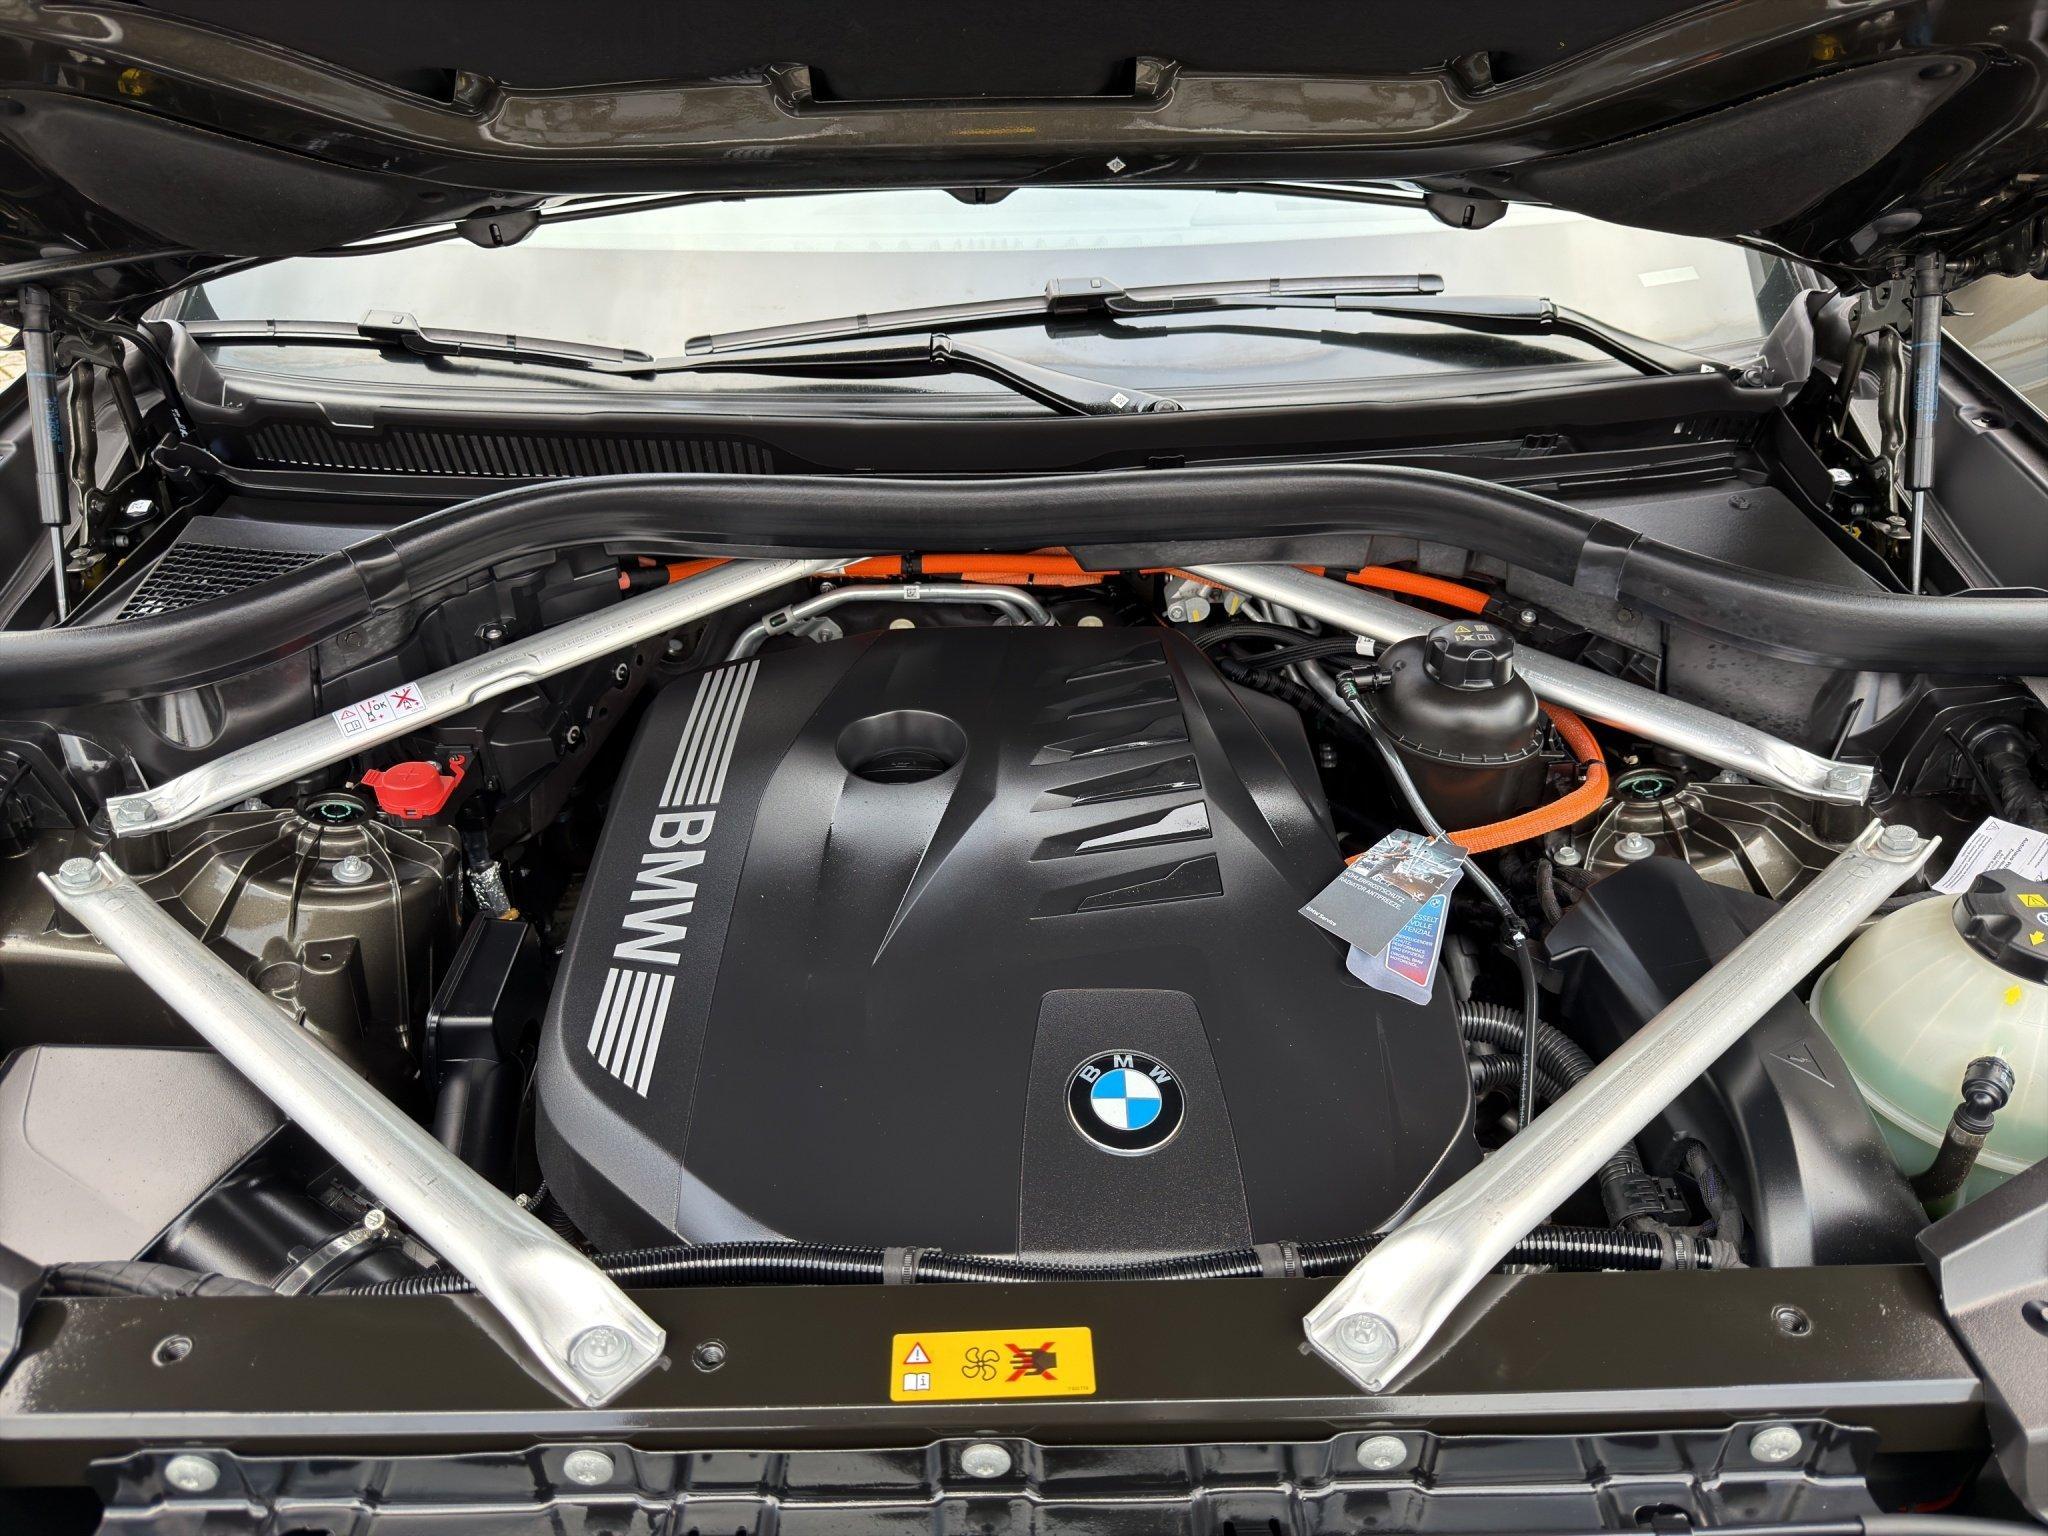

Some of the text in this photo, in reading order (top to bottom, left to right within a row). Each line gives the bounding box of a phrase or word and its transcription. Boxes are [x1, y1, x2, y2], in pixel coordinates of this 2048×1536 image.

[373, 701, 387, 711] OK
[613, 810, 717, 967] BMW
[1306, 905, 1337, 927] BMW Service
[1413, 914, 1439, 923] ESSELT
[1404, 925, 1433, 938] TENZIAL.
[1079, 1054, 1172, 1085] BMW
